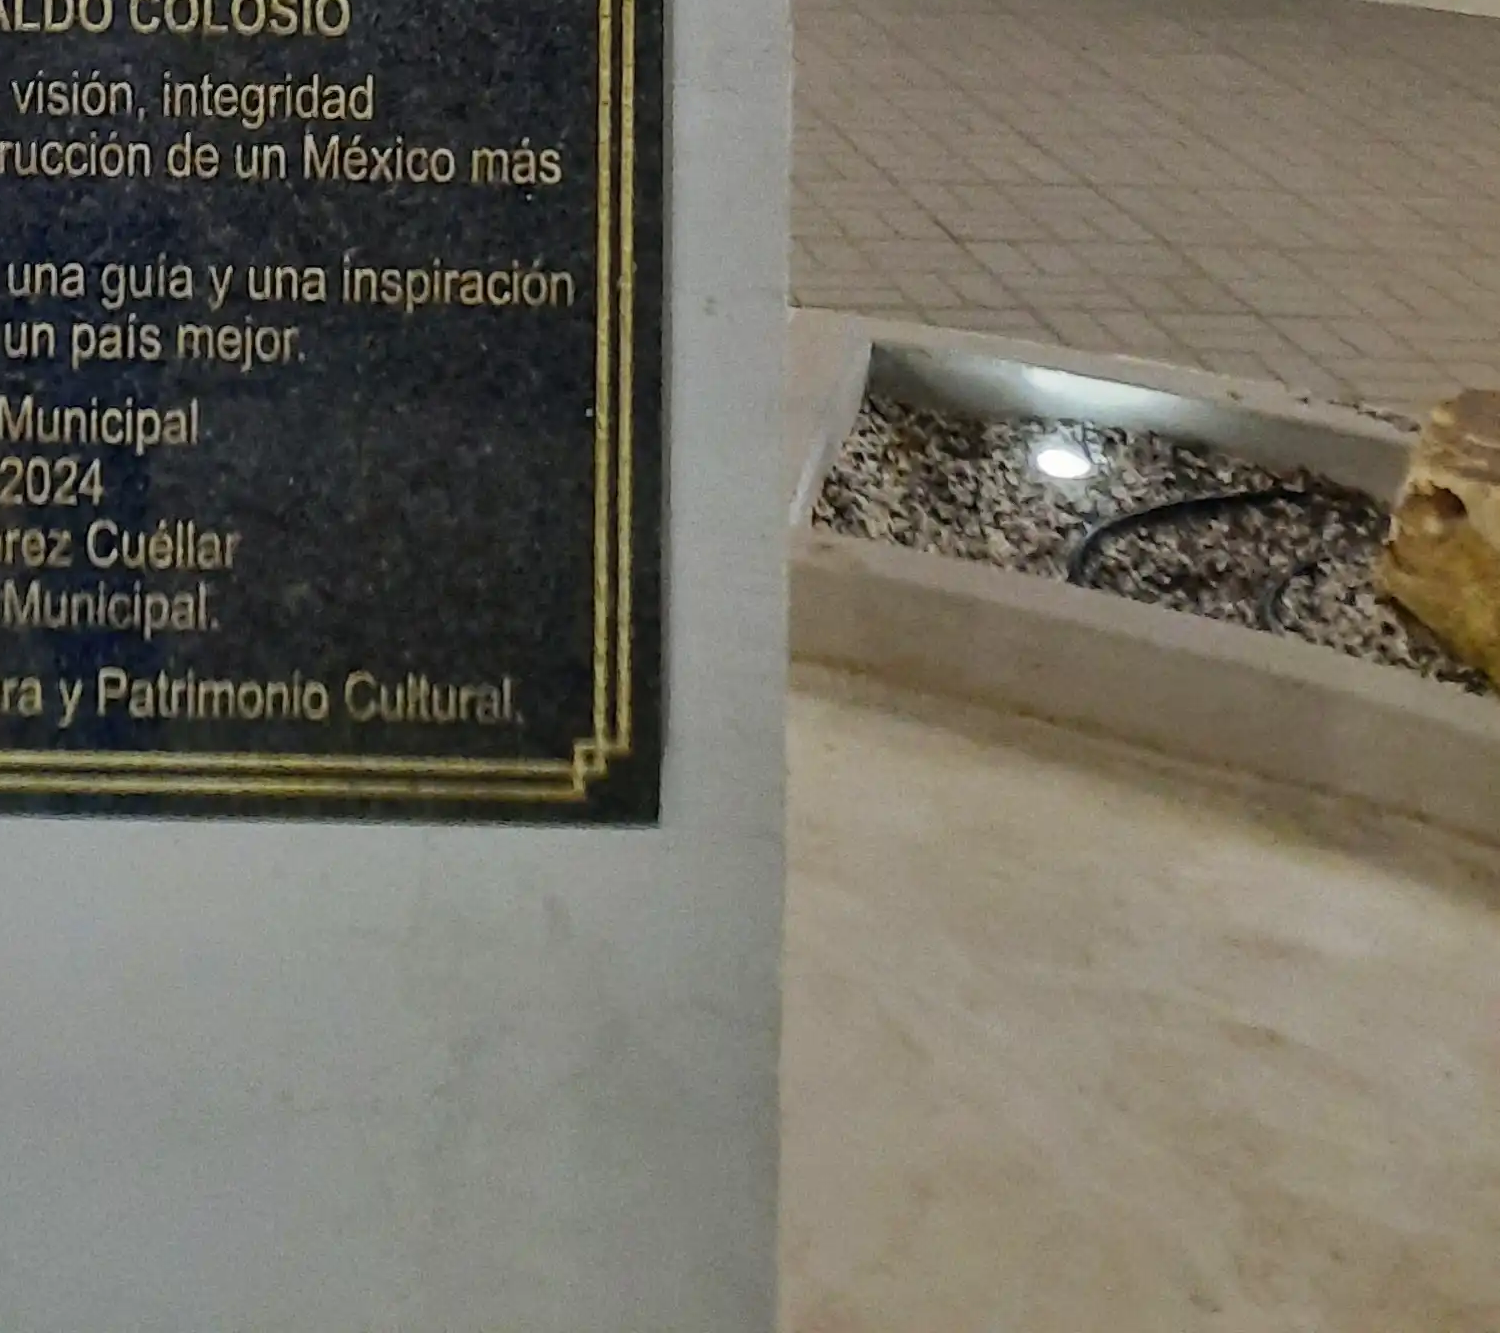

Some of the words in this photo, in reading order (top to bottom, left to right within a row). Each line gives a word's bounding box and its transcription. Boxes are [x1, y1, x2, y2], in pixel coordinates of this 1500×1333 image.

[12, 70, 145, 122] visión,
[163, 74, 374, 127] integridad
[168, 134, 218, 179] de
[235, 143, 285, 179] un
[304, 133, 455, 183] México
[471, 138, 563, 184] más
[8, 263, 85, 299] una
[101, 253, 194, 308] guía
[209, 267, 232, 307] y
[249, 265, 325, 302] una
[342, 259, 575, 313] inspiración
[5, 323, 55, 358] un
[72, 315, 161, 368] país
[178, 317, 305, 372] mejor.
[87, 520, 241, 572] Cuéllar
[2, 581, 218, 638] Municipal.
[58, 678, 82, 727] y
[98, 668, 329, 719] Patrimonio
[345, 673, 521, 722] Cultural.
